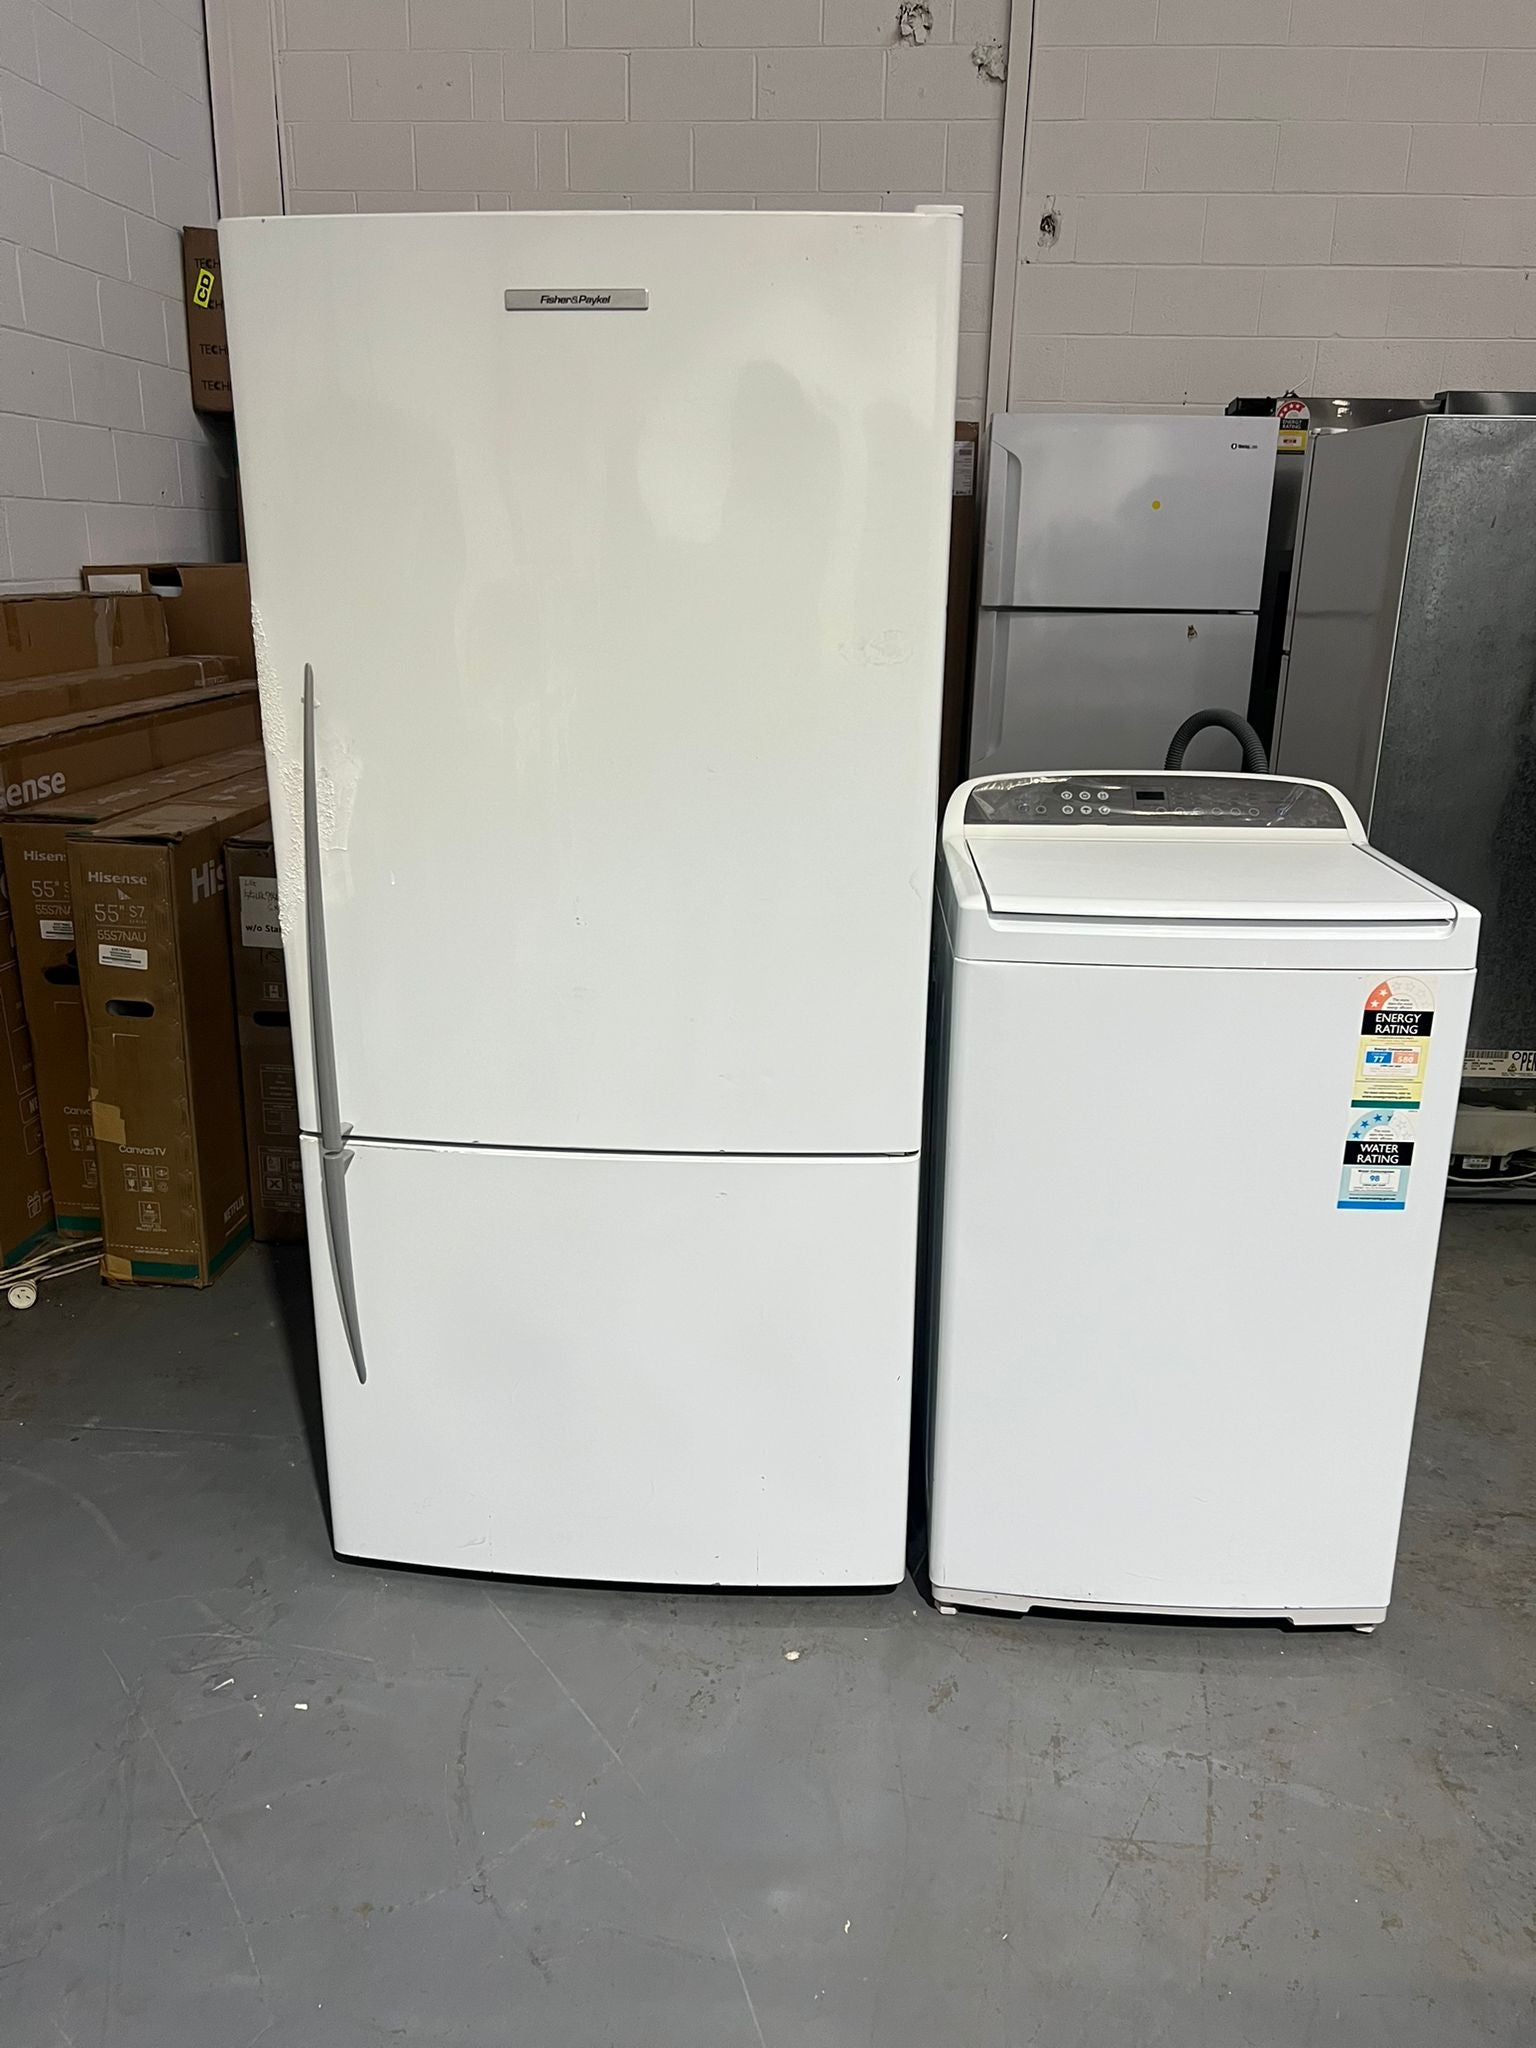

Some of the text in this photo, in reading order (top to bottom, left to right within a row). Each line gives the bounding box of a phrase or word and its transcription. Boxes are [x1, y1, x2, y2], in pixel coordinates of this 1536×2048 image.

[197, 274, 211, 302] CD
[87, 871, 148, 885] Hisense
[129, 905, 145, 918] S7
[97, 929, 147, 943] 55S7NAU
[1375, 1013, 1422, 1024] ENERGY
[1375, 1024, 1419, 1035] RATING
[1373, 1055, 1385, 1063] 77
[119, 1144, 167, 1157] CanvasTV
[1360, 1143, 1399, 1153] WATER
[1356, 1154, 1399, 1164] RATING
[1369, 1174, 1381, 1182] 98
